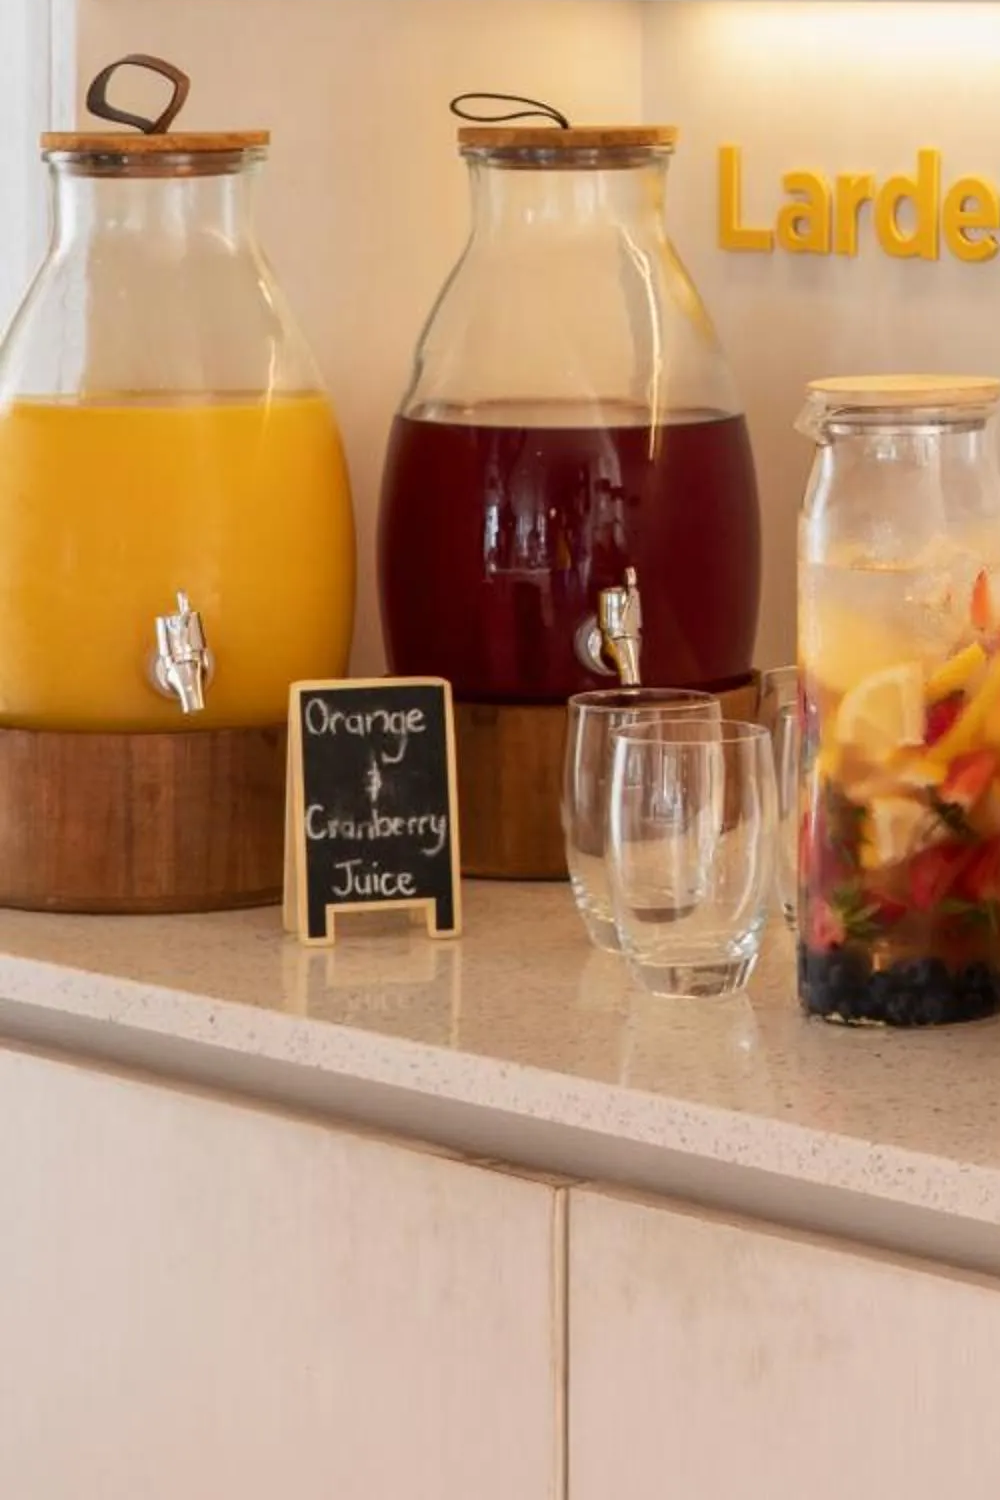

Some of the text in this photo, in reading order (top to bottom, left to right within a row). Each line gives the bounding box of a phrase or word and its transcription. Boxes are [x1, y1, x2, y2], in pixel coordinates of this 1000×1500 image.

[305, 699, 427, 764] Orange
[306, 803, 447, 856] Cranberry
[333, 858, 418, 896] Juice
